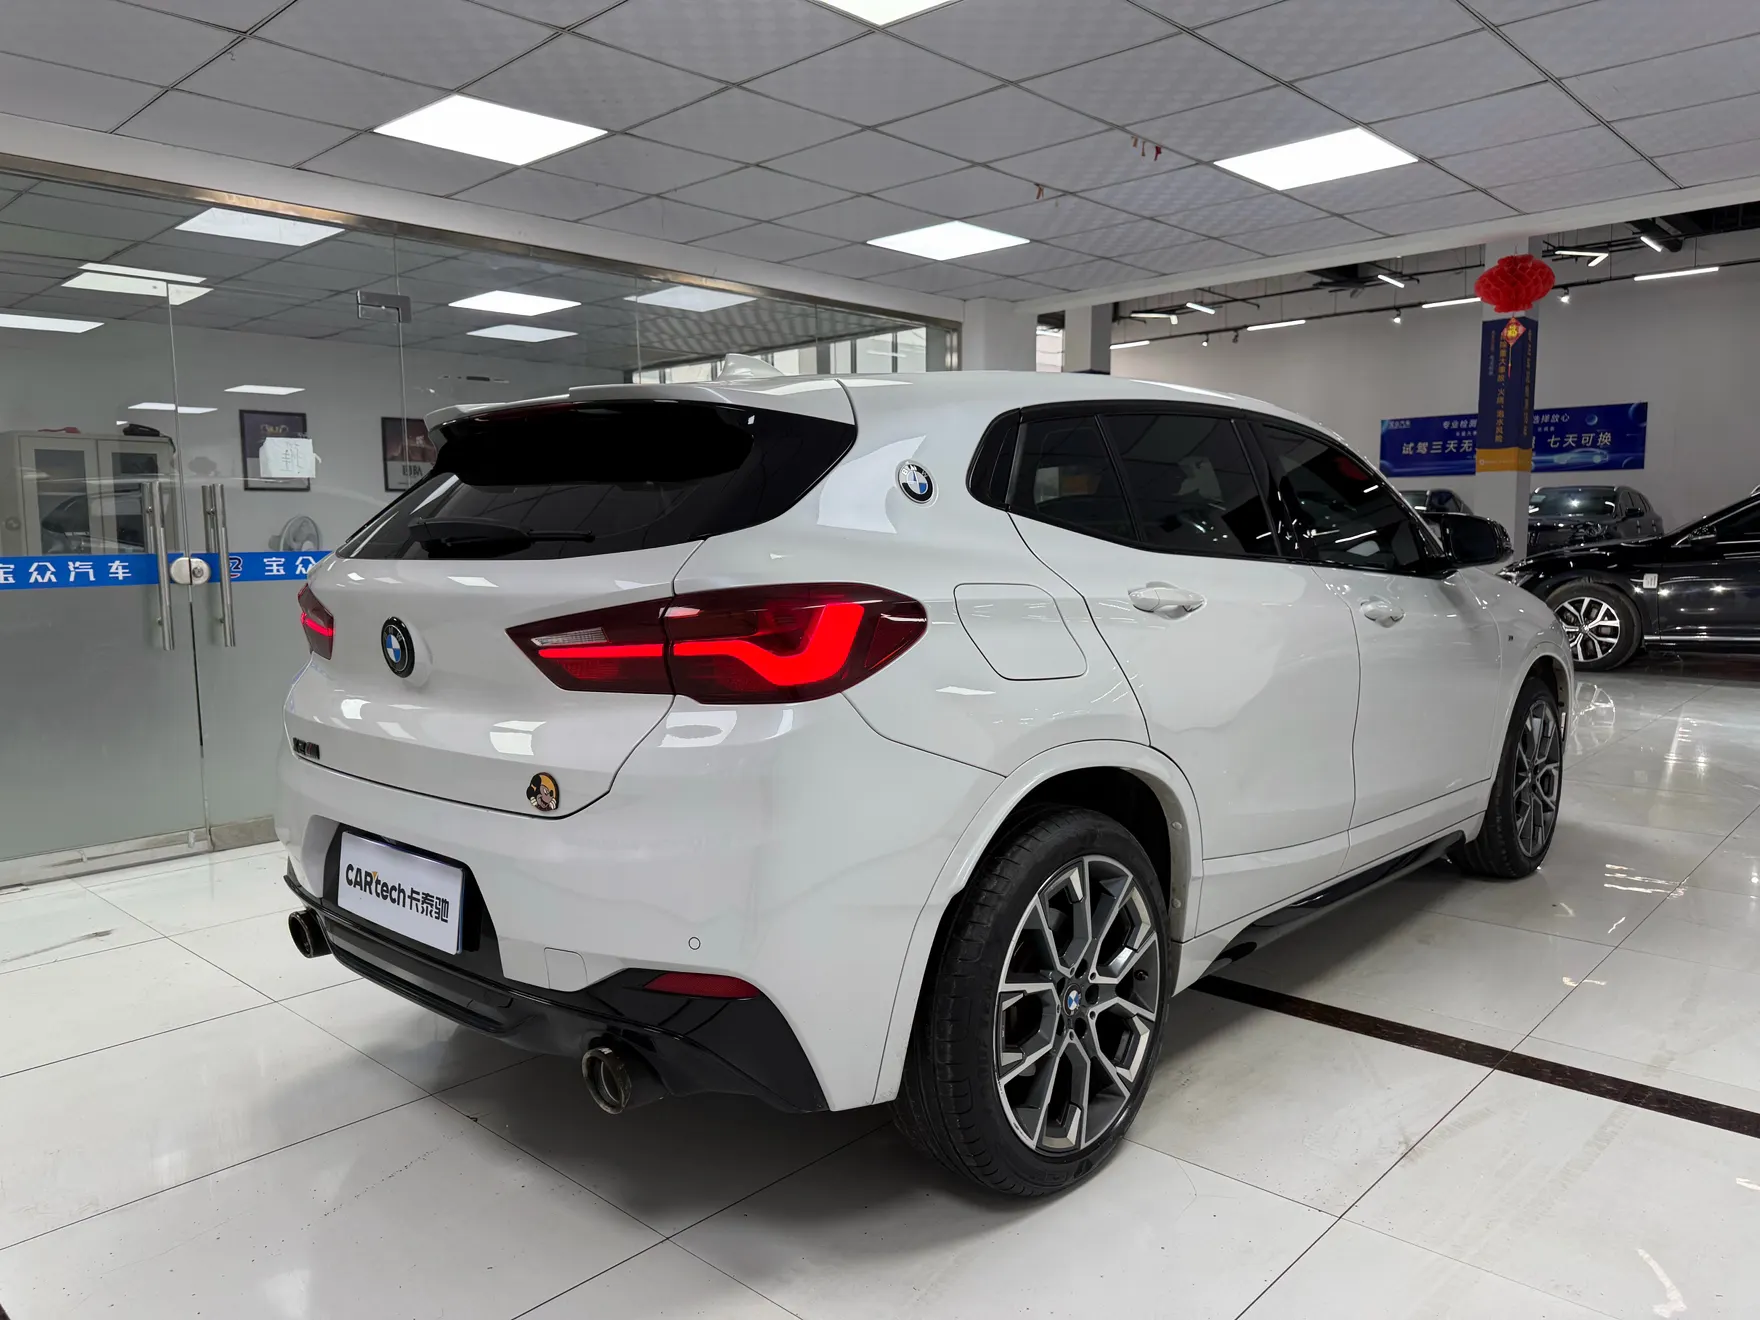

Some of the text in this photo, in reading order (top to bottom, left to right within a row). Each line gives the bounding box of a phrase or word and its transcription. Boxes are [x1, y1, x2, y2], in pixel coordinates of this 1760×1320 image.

[1547, 432, 1612, 448] 七天可换
[345, 863, 449, 924] CARtech 卡泰驰
